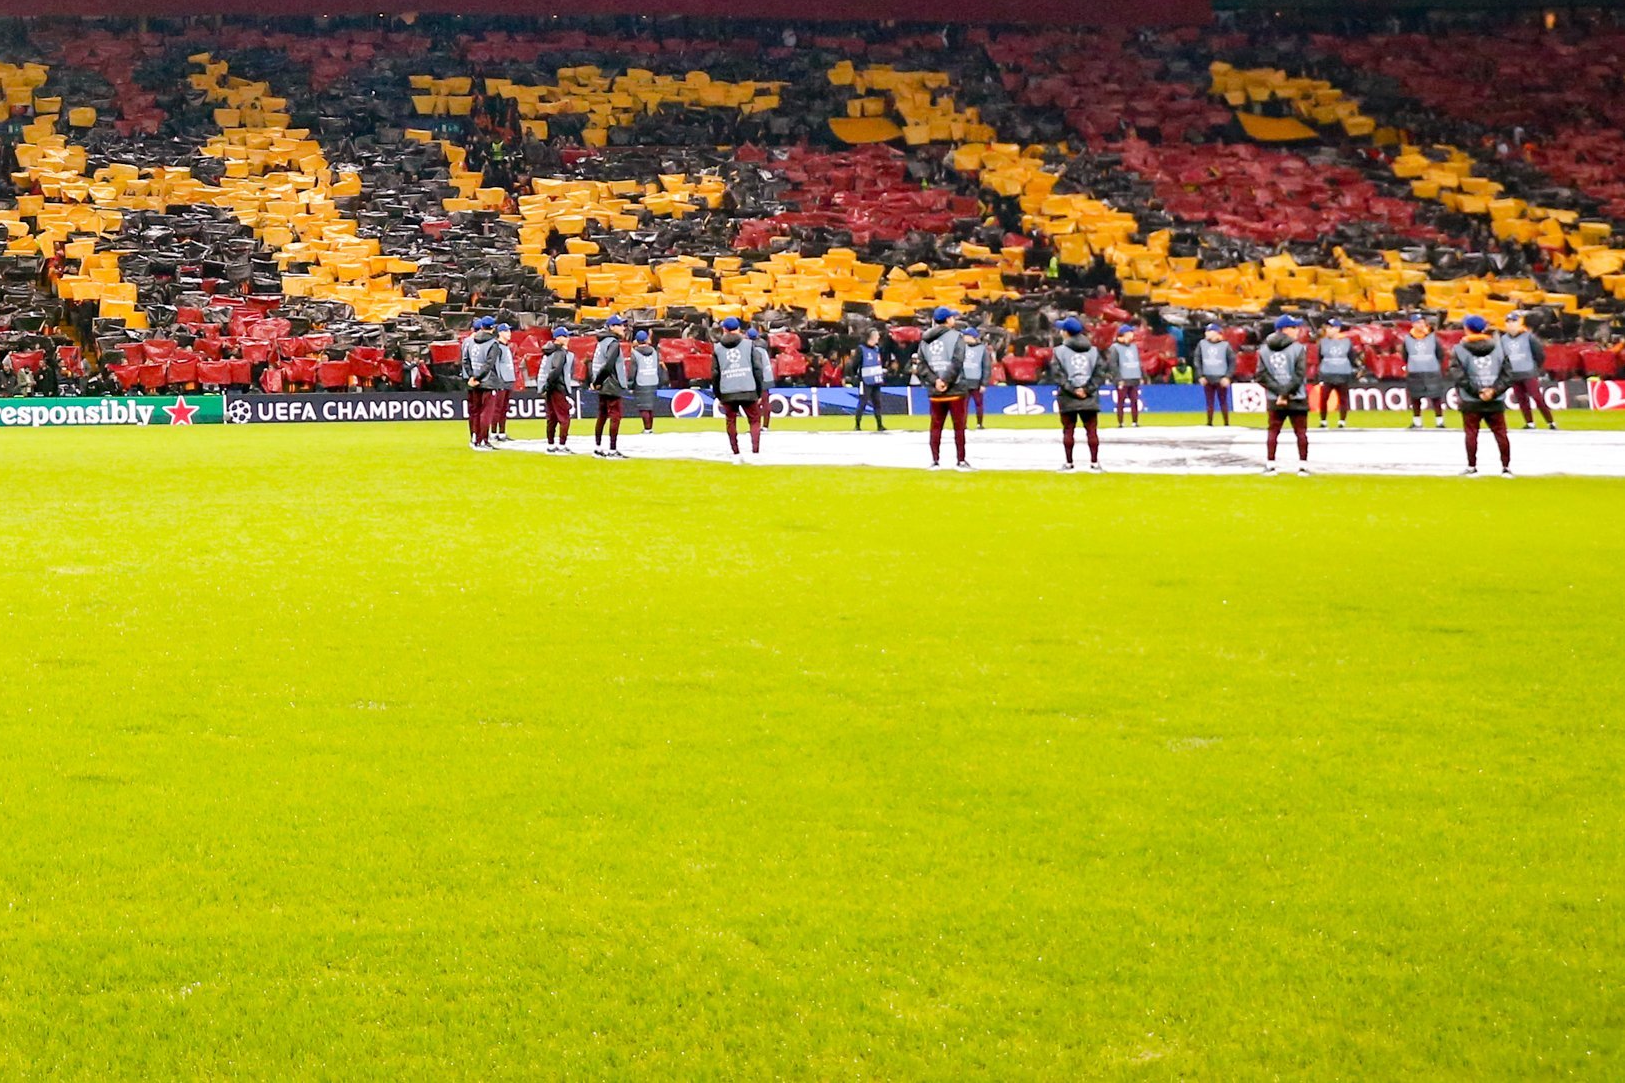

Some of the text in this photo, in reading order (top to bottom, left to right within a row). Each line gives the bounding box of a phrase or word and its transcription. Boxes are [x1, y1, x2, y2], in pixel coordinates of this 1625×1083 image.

[257, 398, 547, 422] UEFA CHAMPIONS LGUE
